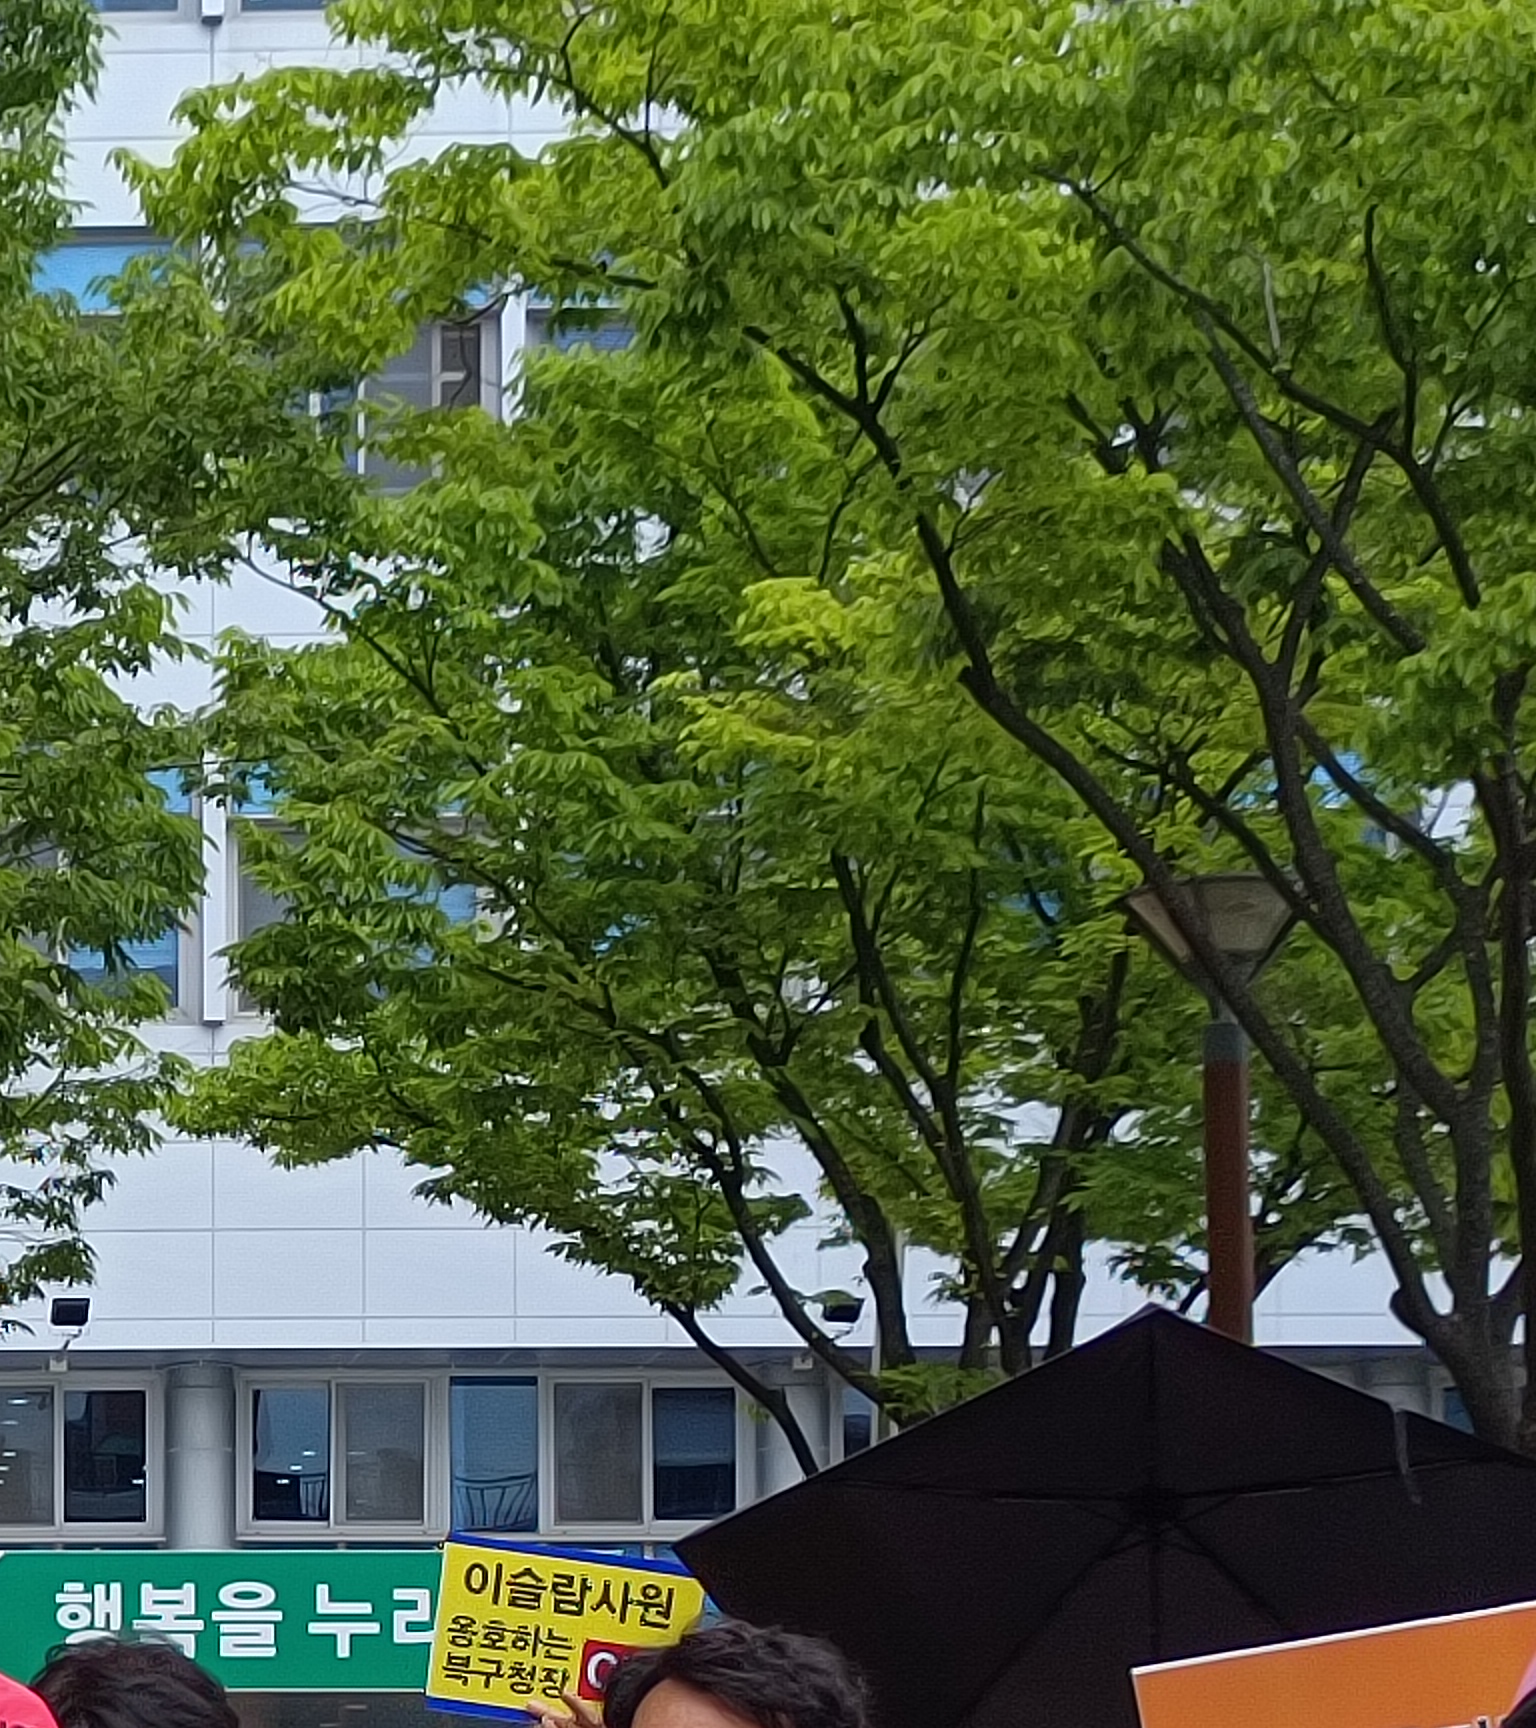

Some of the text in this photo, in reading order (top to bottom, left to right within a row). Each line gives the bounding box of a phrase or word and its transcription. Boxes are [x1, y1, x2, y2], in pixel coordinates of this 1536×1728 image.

[55, 1581, 283, 1659] 행복을
[465, 1562, 675, 1629] 이슬람사원
[447, 1615, 576, 1660] 옹호하는
[442, 1651, 569, 1698] 북구청장
